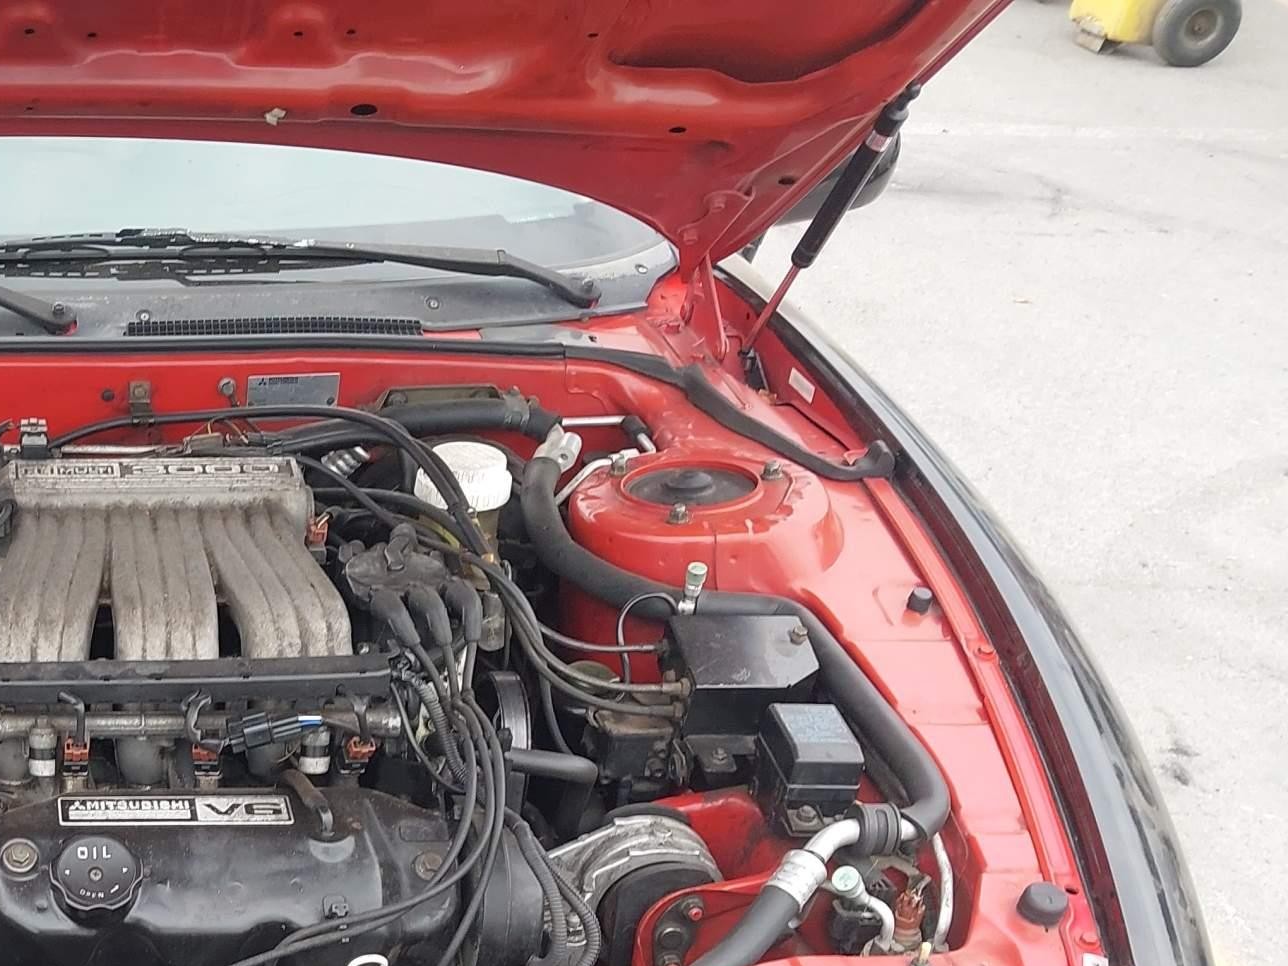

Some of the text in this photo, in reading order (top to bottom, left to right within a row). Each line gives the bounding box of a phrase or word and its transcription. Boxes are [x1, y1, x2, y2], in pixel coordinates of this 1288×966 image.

[85, 800, 283, 816] MITSUBISHI V6
[77, 846, 112, 860] OIL
[79, 887, 106, 899] OPEN
